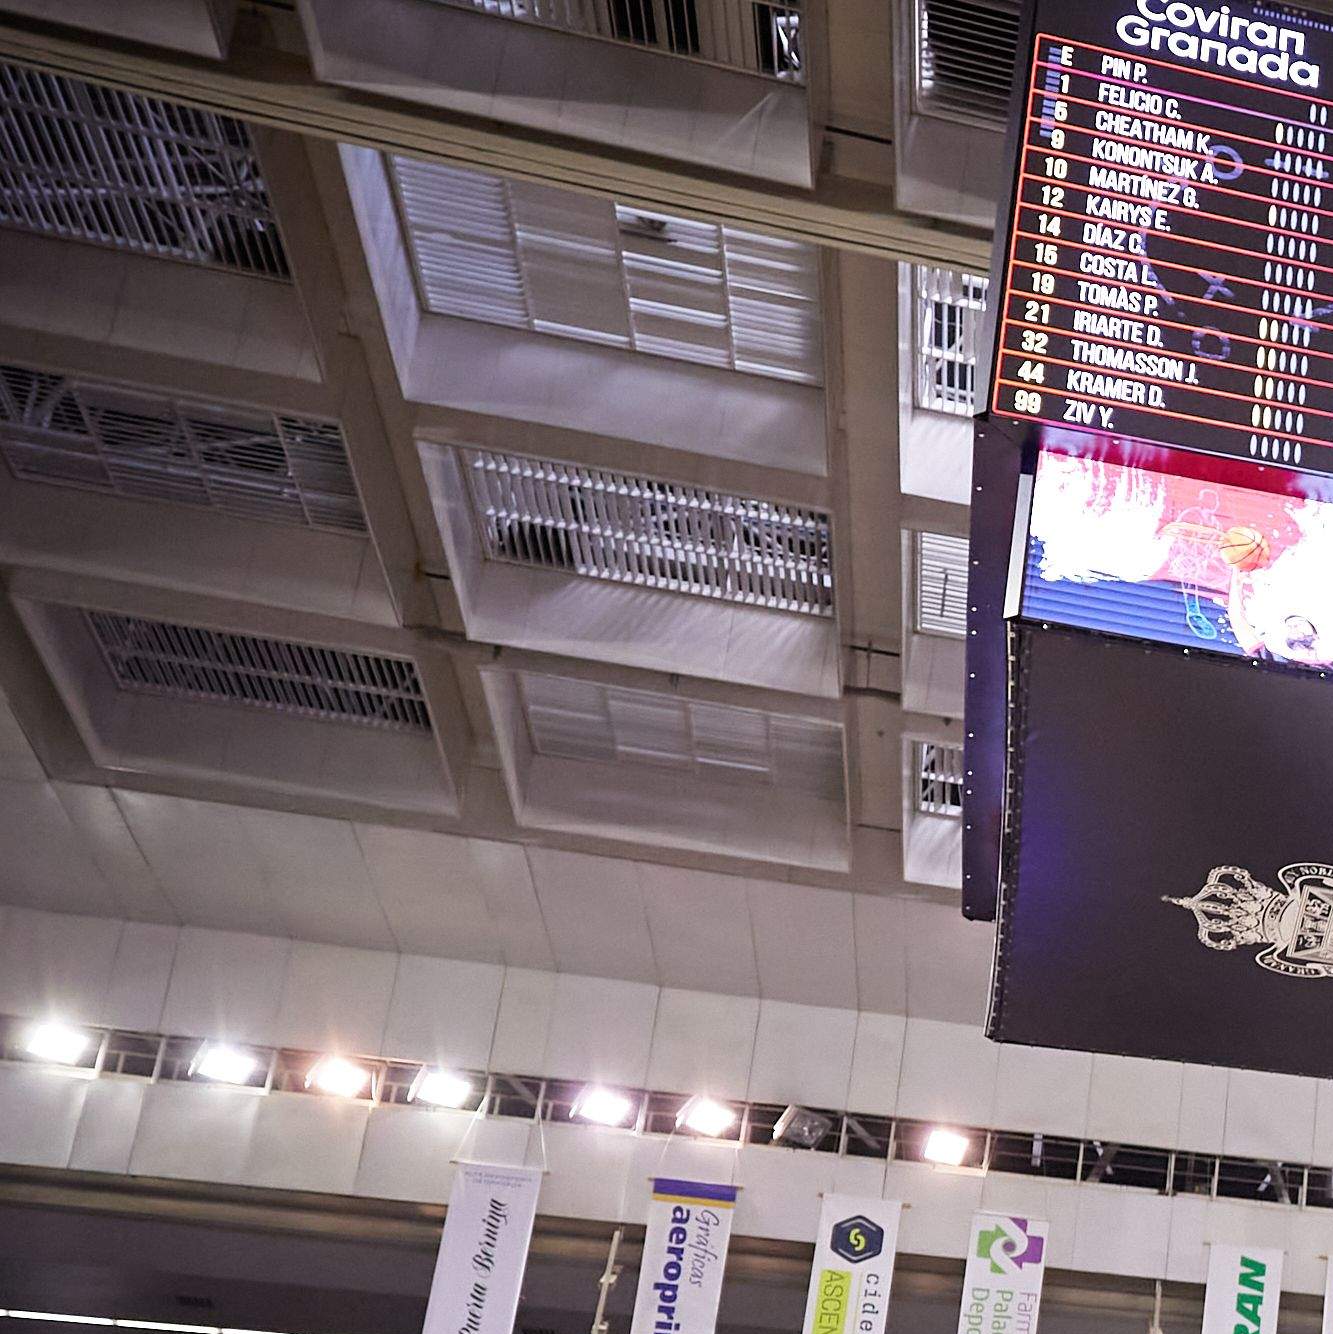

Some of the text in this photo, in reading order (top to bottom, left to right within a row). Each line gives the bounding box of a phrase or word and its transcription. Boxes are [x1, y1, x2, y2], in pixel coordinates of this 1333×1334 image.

[1136, 0, 1305, 55] Coviran
[1060, 46, 1148, 83] E PIN P.
[1116, 15, 1321, 89] Granada
[1060, 74, 1070, 94] 1
[1098, 82, 1163, 115] FELICIO
[1165, 99, 1182, 120] C.
[1095, 111, 1194, 149] CHEATHAM
[1196, 133, 1214, 154] K.
[1051, 129, 1219, 184] 9 KONONTSUK A.
[1045, 157, 1200, 209] 10 MARTÍNEZ G.
[1041, 185, 1171, 231] 12 KAIRYS E.
[1039, 214, 1061, 237] 14
[1128, 233, 1146, 255] C.
[1080, 252, 1138, 284] COSTA
[1142, 265, 1157, 286] L.
[1032, 271, 1055, 295] 19
[1144, 295, 1159, 316] P.
[1024, 300, 1050, 324] 21
[1073, 309, 1144, 344] IRIARTE
[1147, 324, 1164, 348] D.
[1021, 330, 1049, 354] 32
[1071, 339, 1183, 382] THOMASSON
[1185, 362, 1199, 384] J.
[1017, 361, 1045, 384] 44
[1066, 369, 1146, 404] KRAMER
[1148, 386, 1166, 408] D.
[1014, 390, 1114, 429] 99 ZIV Y.
